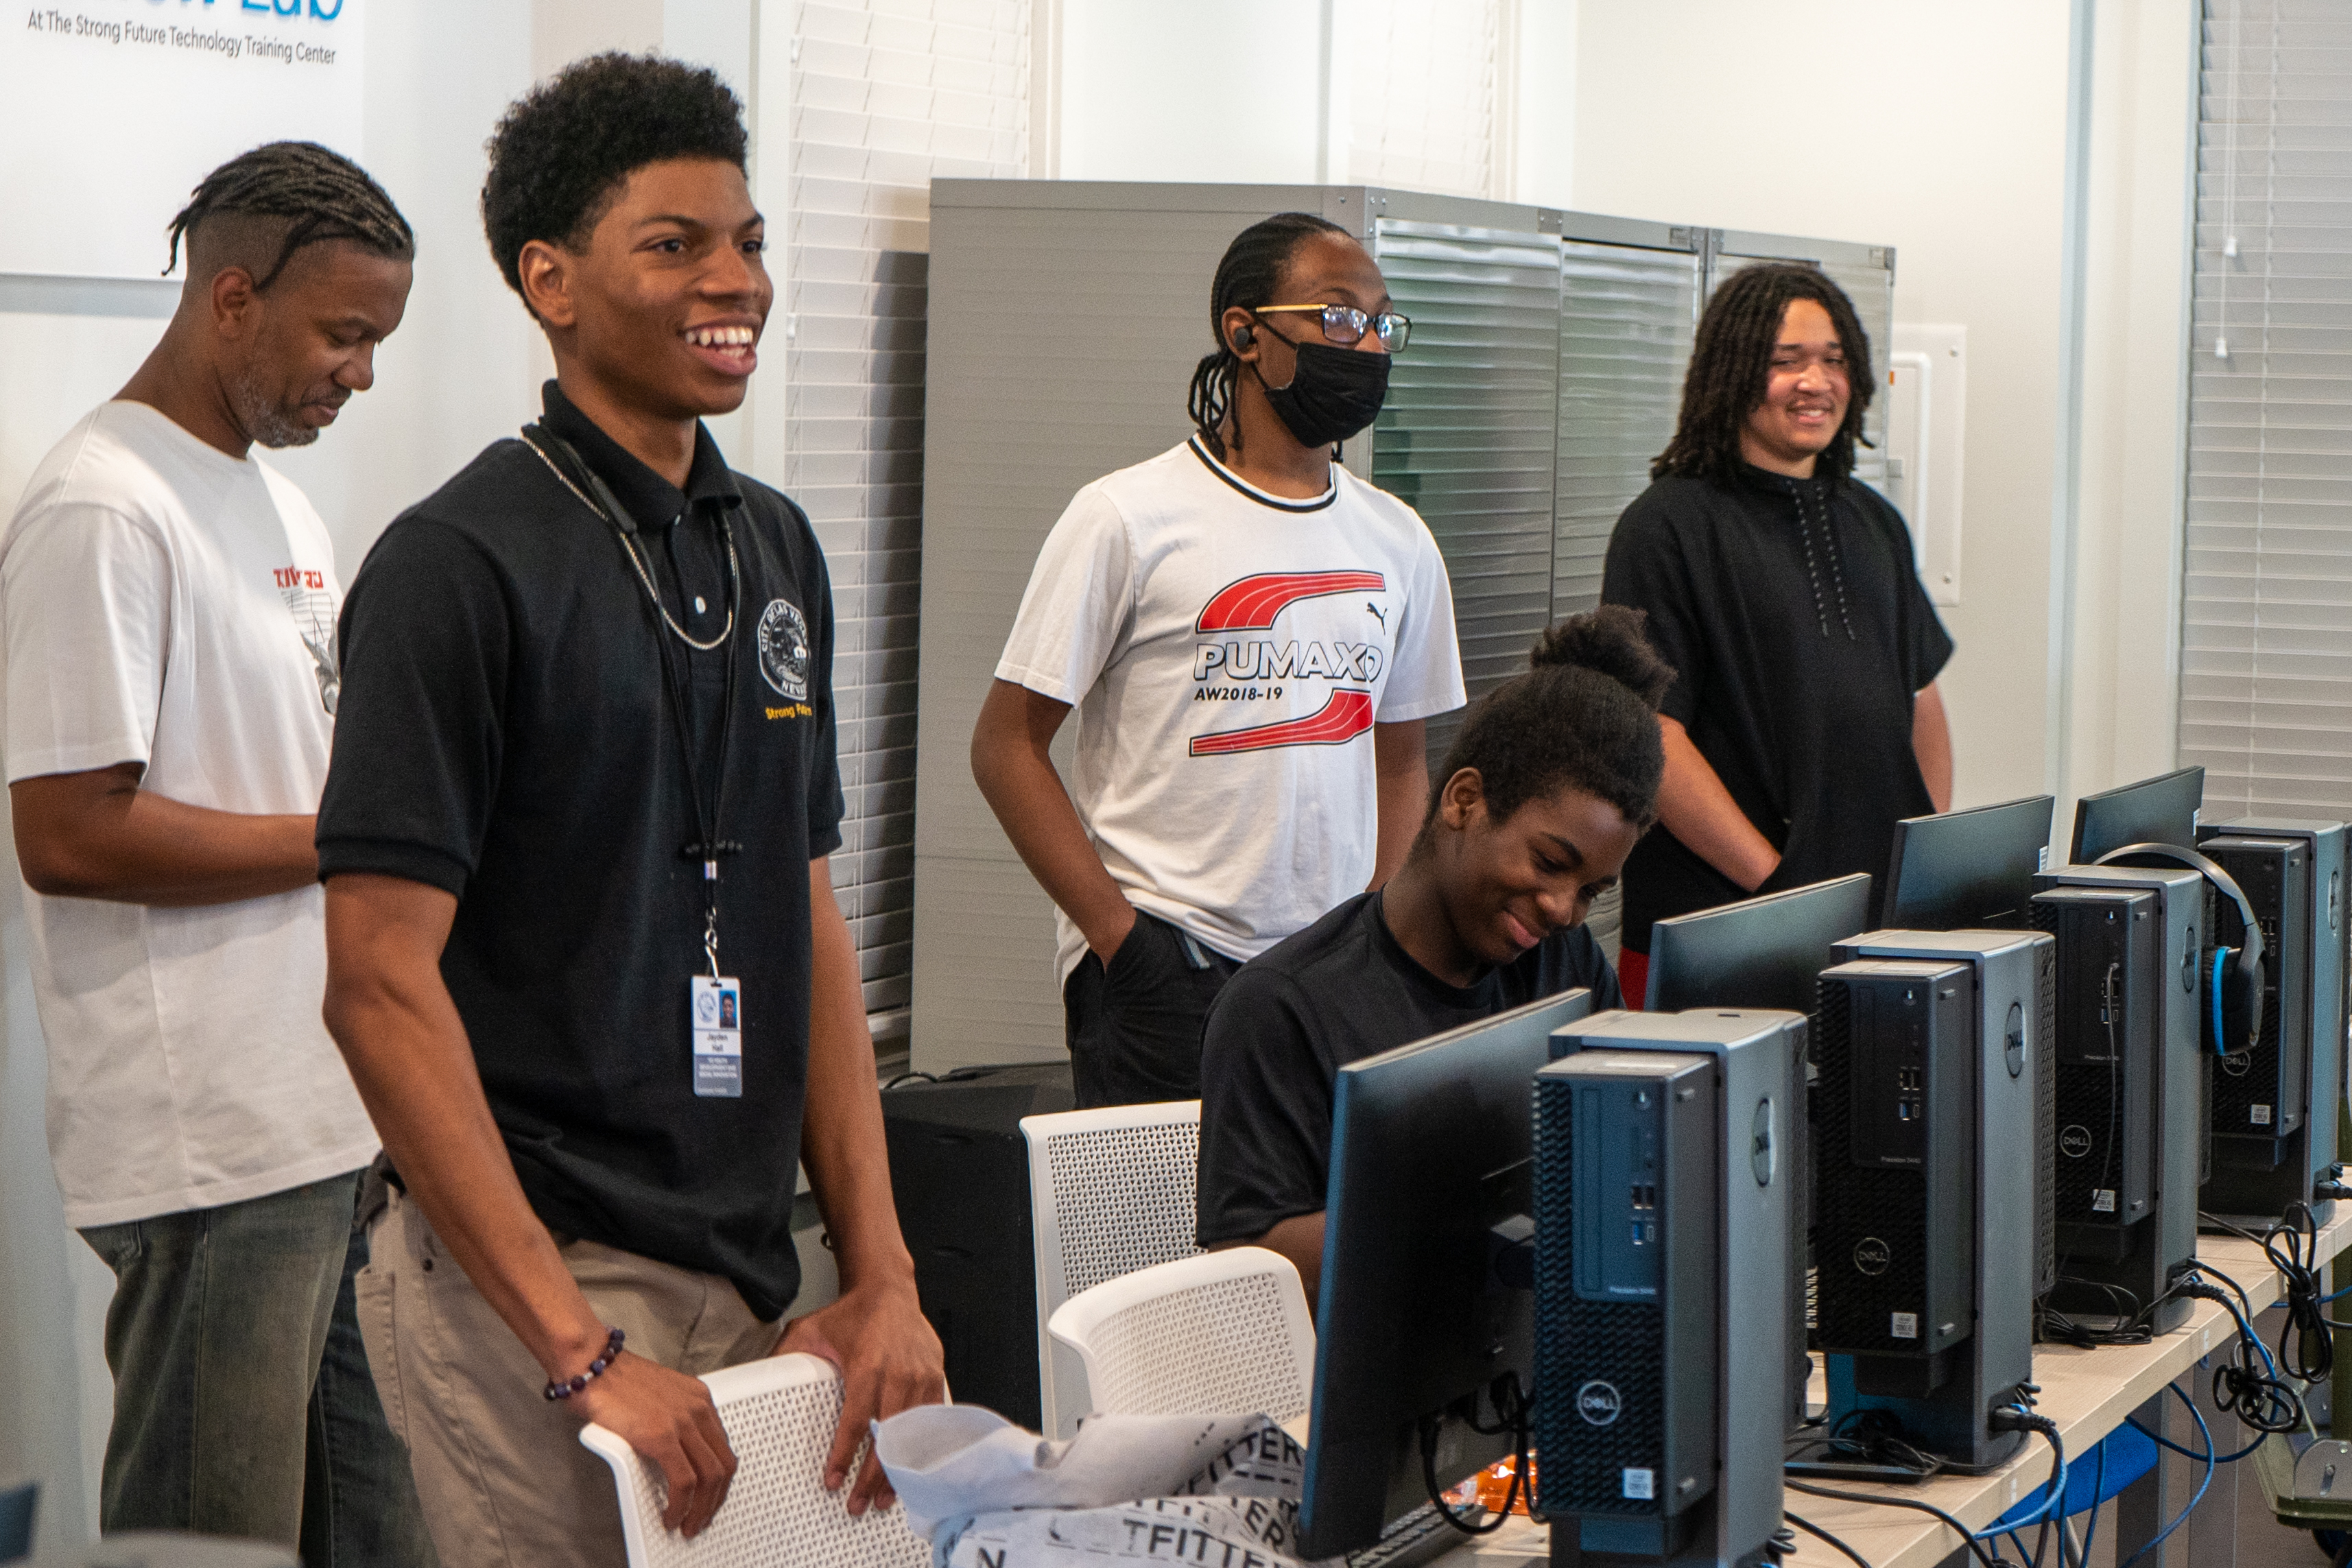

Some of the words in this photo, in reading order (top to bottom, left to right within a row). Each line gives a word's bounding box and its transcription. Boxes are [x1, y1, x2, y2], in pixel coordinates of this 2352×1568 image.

[27, 9, 43, 31] At
[46, 9, 71, 33] The
[76, 13, 120, 44] Strong
[124, 20, 166, 44] Future
[169, 26, 241, 58] Technology
[245, 35, 292, 64] Training
[296, 41, 336, 64] Center
[1194, 687, 1283, 701] AW2018-19
[765, 706, 796, 720] Strong
[2063, 1136, 2089, 1146] DELL
[1857, 1250, 1887, 1262] DELL
[1582, 1396, 1617, 1410] DELL
